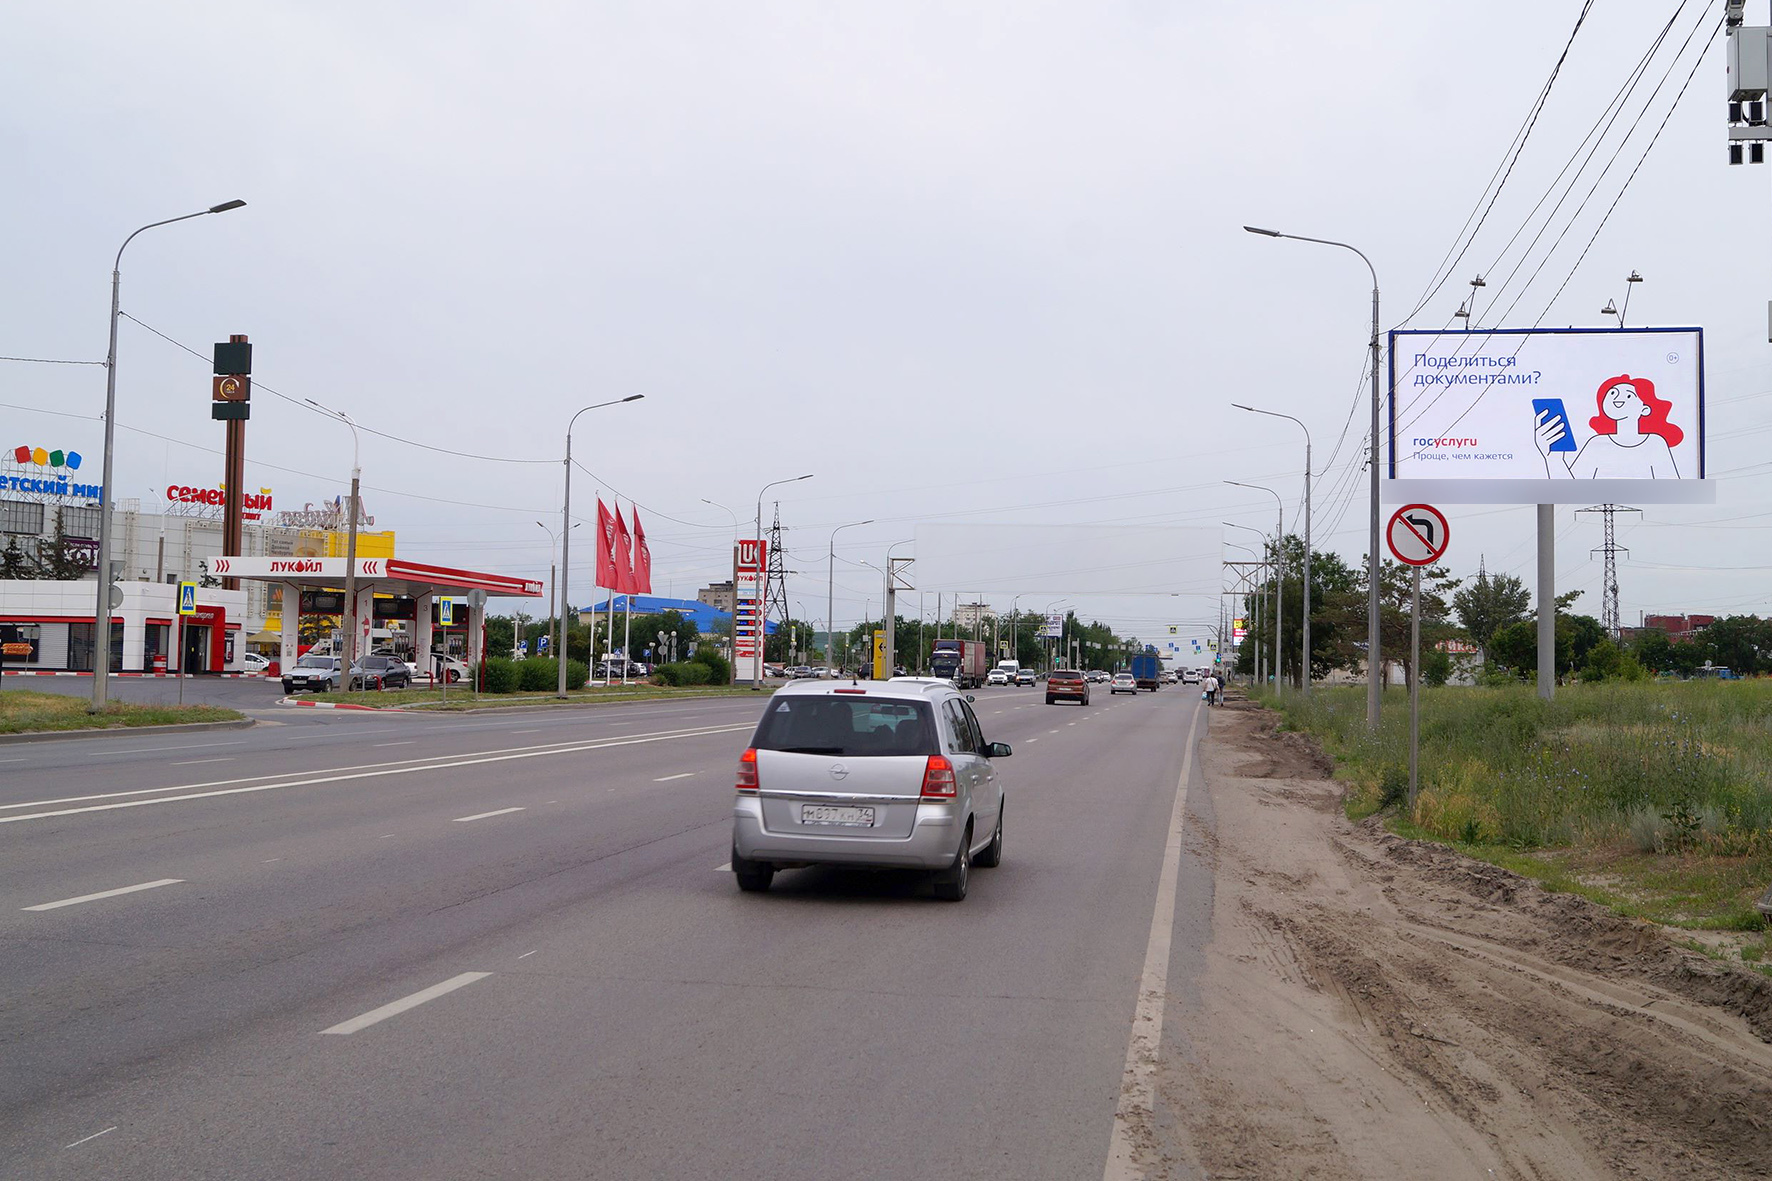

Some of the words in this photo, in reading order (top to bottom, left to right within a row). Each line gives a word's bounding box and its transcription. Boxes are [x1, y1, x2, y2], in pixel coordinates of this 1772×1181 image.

[1414, 353, 1516, 368] Поделиться
[1668, 354, 1678, 362] 0+
[1413, 370, 1542, 387] документами?
[1413, 437, 1477, 450] госуслуги
[1413, 452, 1450, 462] Проще,
[1474, 452, 1513, 460] кажется
[0, 475, 68, 495] етский
